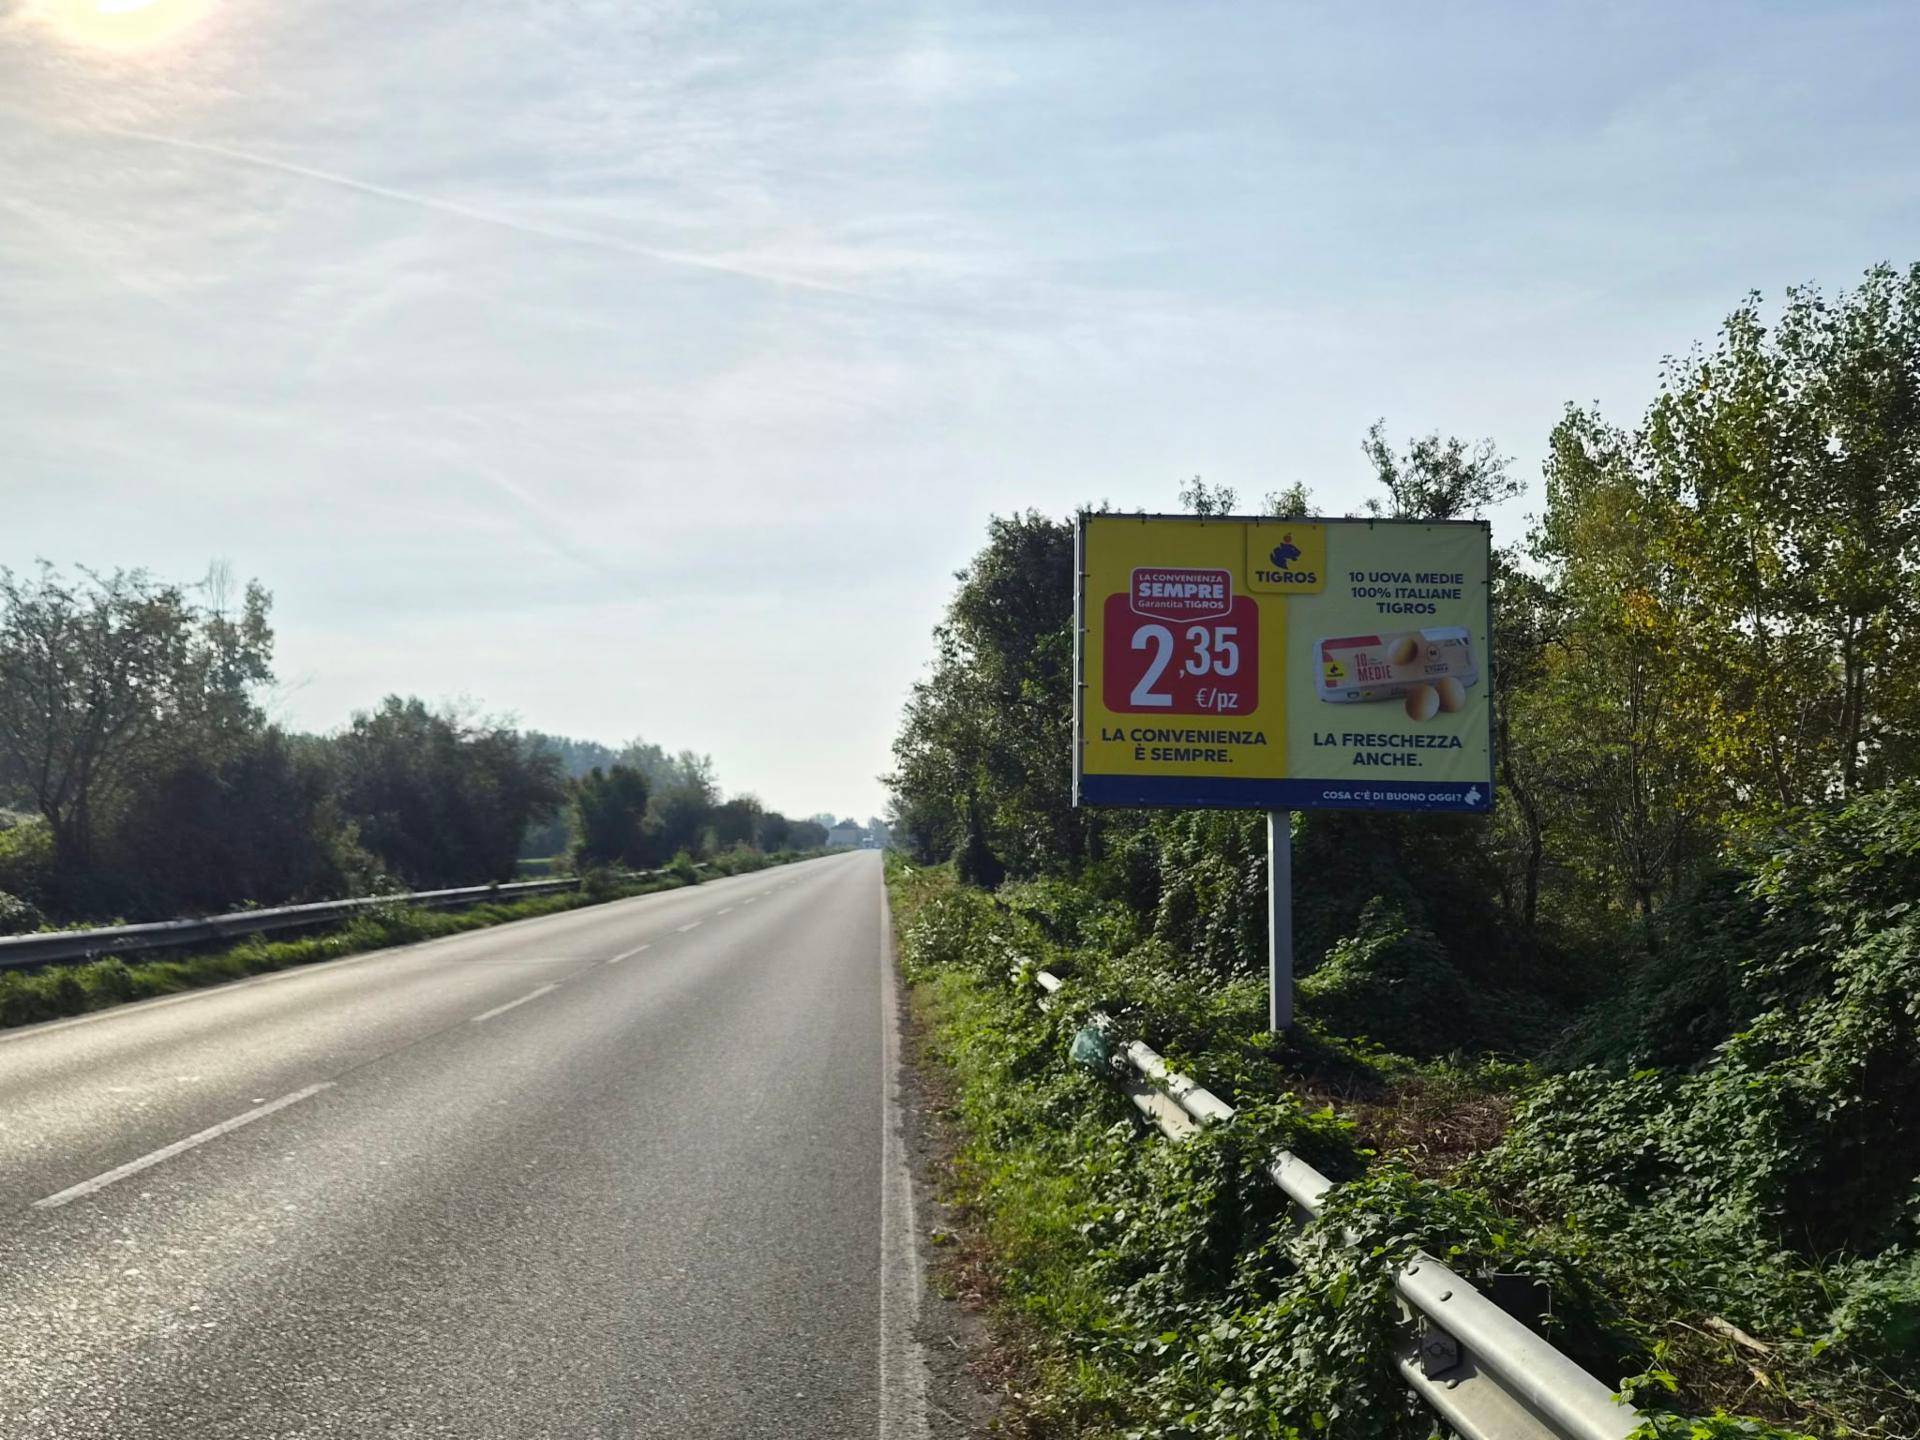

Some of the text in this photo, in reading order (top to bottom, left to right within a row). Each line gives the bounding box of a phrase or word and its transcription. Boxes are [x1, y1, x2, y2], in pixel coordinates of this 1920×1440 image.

[1139, 574, 1223, 582] LA CONVENIENZA
[1255, 570, 1317, 584] TIGROS
[1350, 572, 1464, 585] 10 UOVA MEDIE
[1138, 582, 1224, 599] SEMPRE
[1351, 587, 1462, 600] 100% ITALIANE
[1138, 599, 1224, 609] Garantita TIGROS
[1376, 602, 1436, 614] TIGROS
[1357, 665, 1392, 682] MEDIE
[1196, 688, 1239, 712] €/pz
[1101, 728, 1267, 745] LA CONVENIENZA
[1313, 732, 1462, 749] LA FRESCHEZZA
[1134, 743, 1234, 763] È SEMPRE.
[1352, 752, 1423, 767] ANCHE.
[1322, 789, 1462, 802] COSA C'È DI BUONO OGGI?
